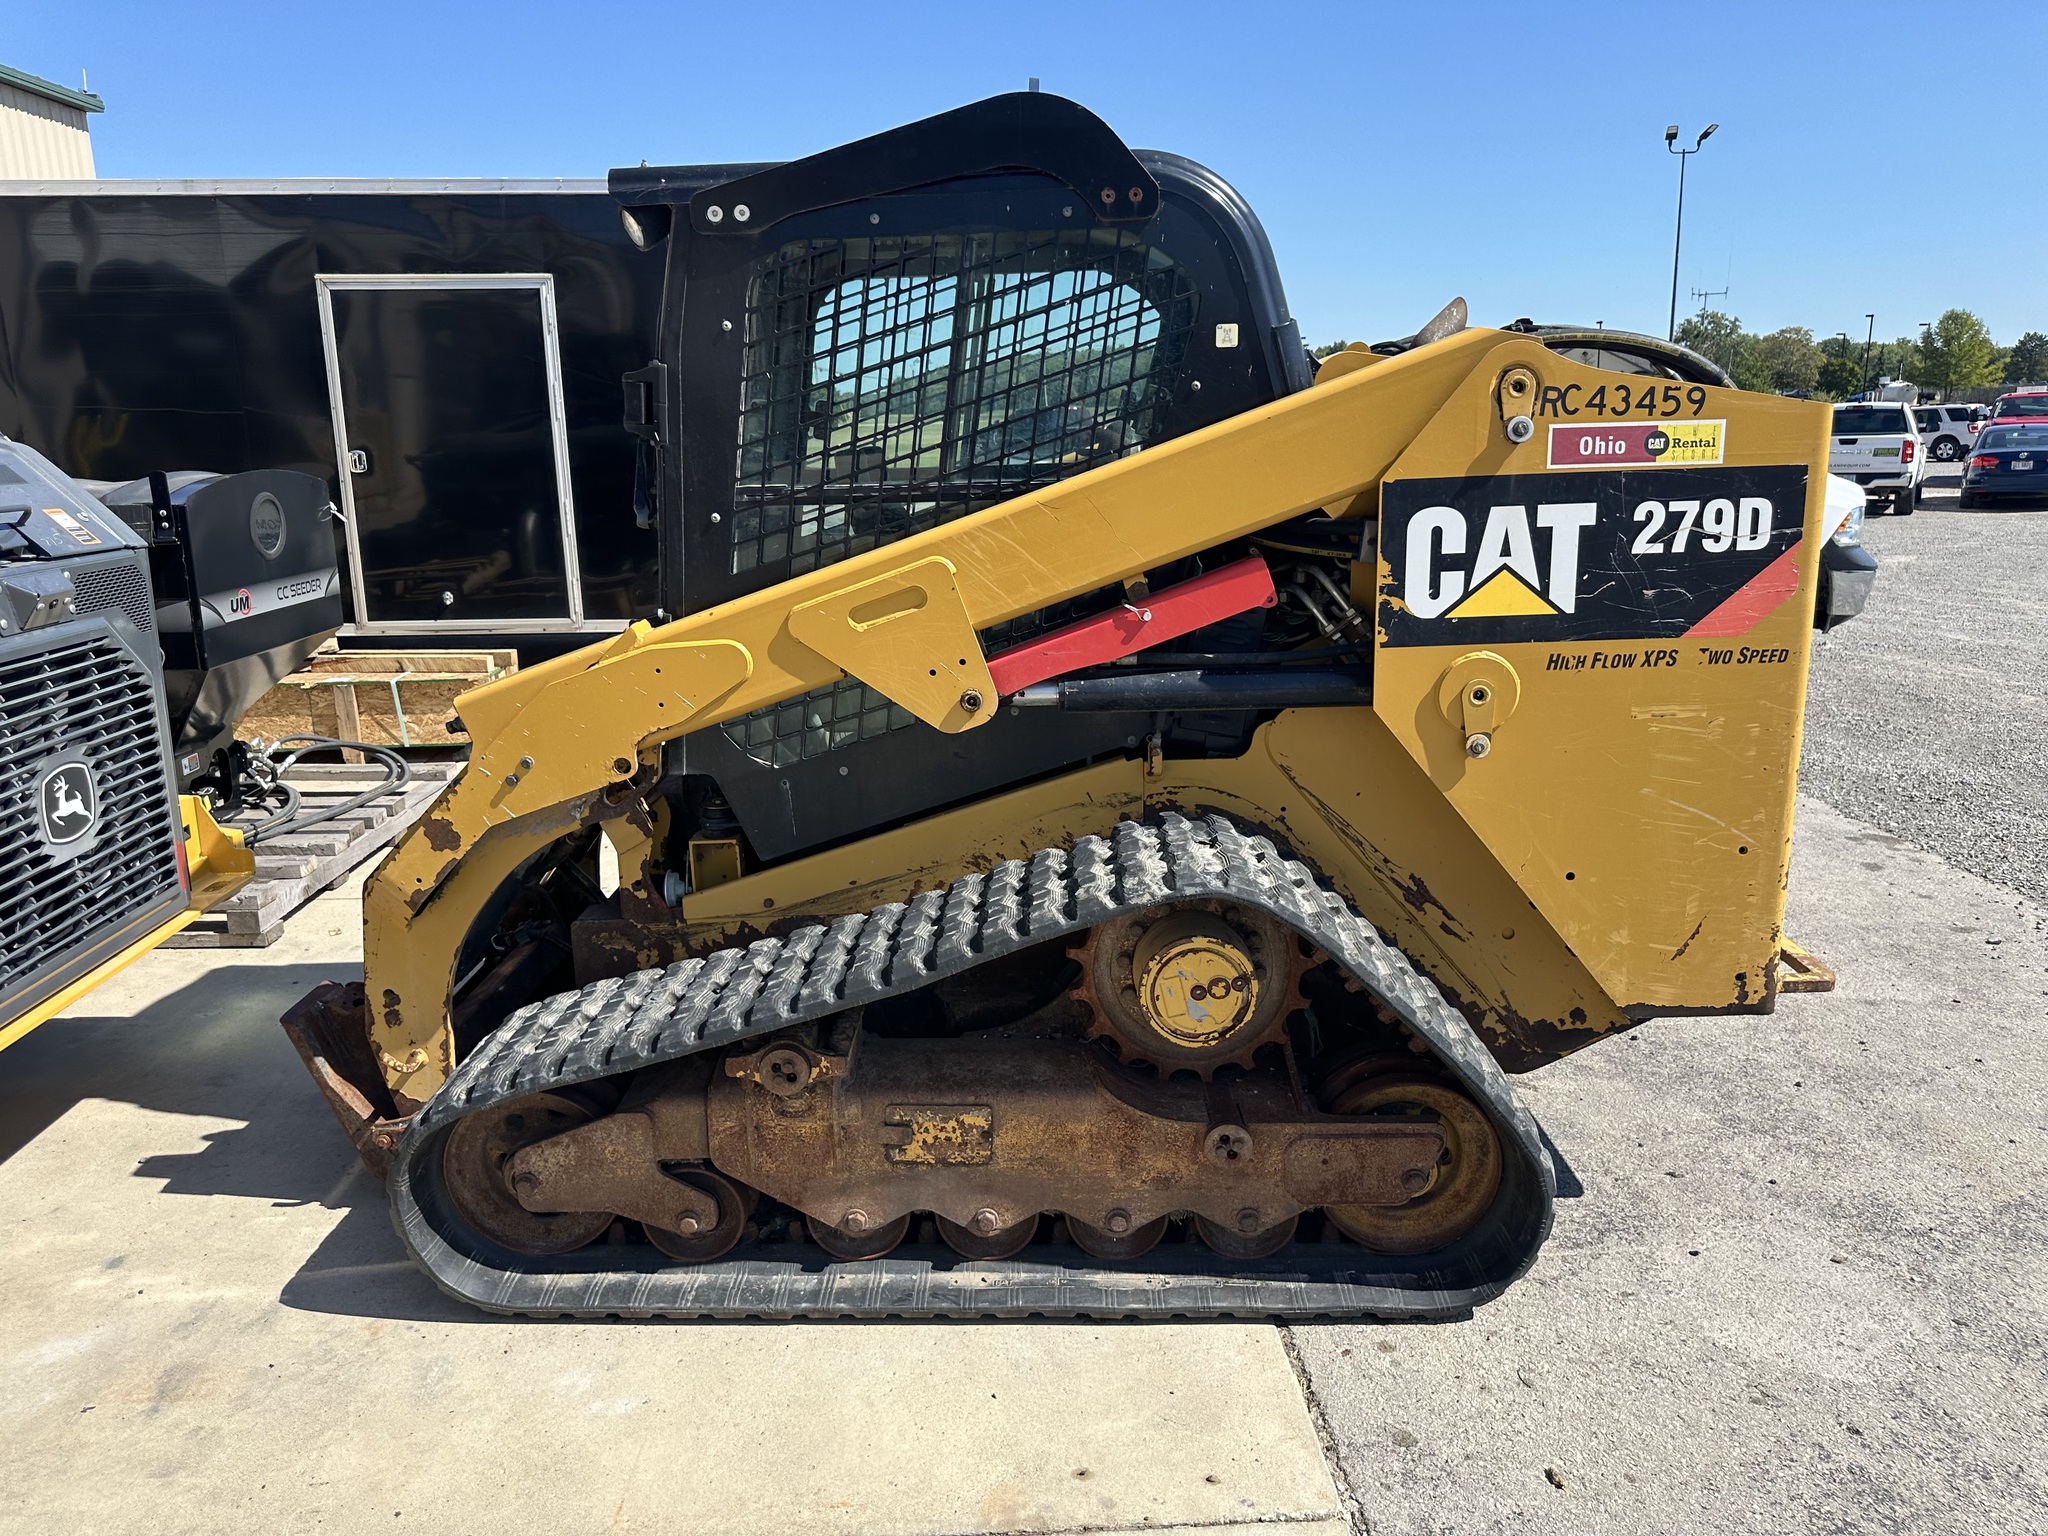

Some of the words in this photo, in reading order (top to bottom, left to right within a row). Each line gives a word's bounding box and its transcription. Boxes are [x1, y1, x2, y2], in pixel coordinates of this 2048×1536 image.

[1539, 384, 1706, 417] RC43459
[1579, 436, 1626, 455] Ohio
[1647, 437, 1666, 450] CAT
[1671, 437, 1716, 448] Rental
[1631, 497, 1772, 554] 279D
[1404, 502, 1597, 619] CAT
[277, 585, 289, 600] CC
[290, 578, 322, 597] SEEDER
[230, 595, 250, 613] UM
[1590, 652, 1637, 669] FLOW
[1640, 649, 1679, 667] XPS
[1737, 646, 1789, 664] SPEED
